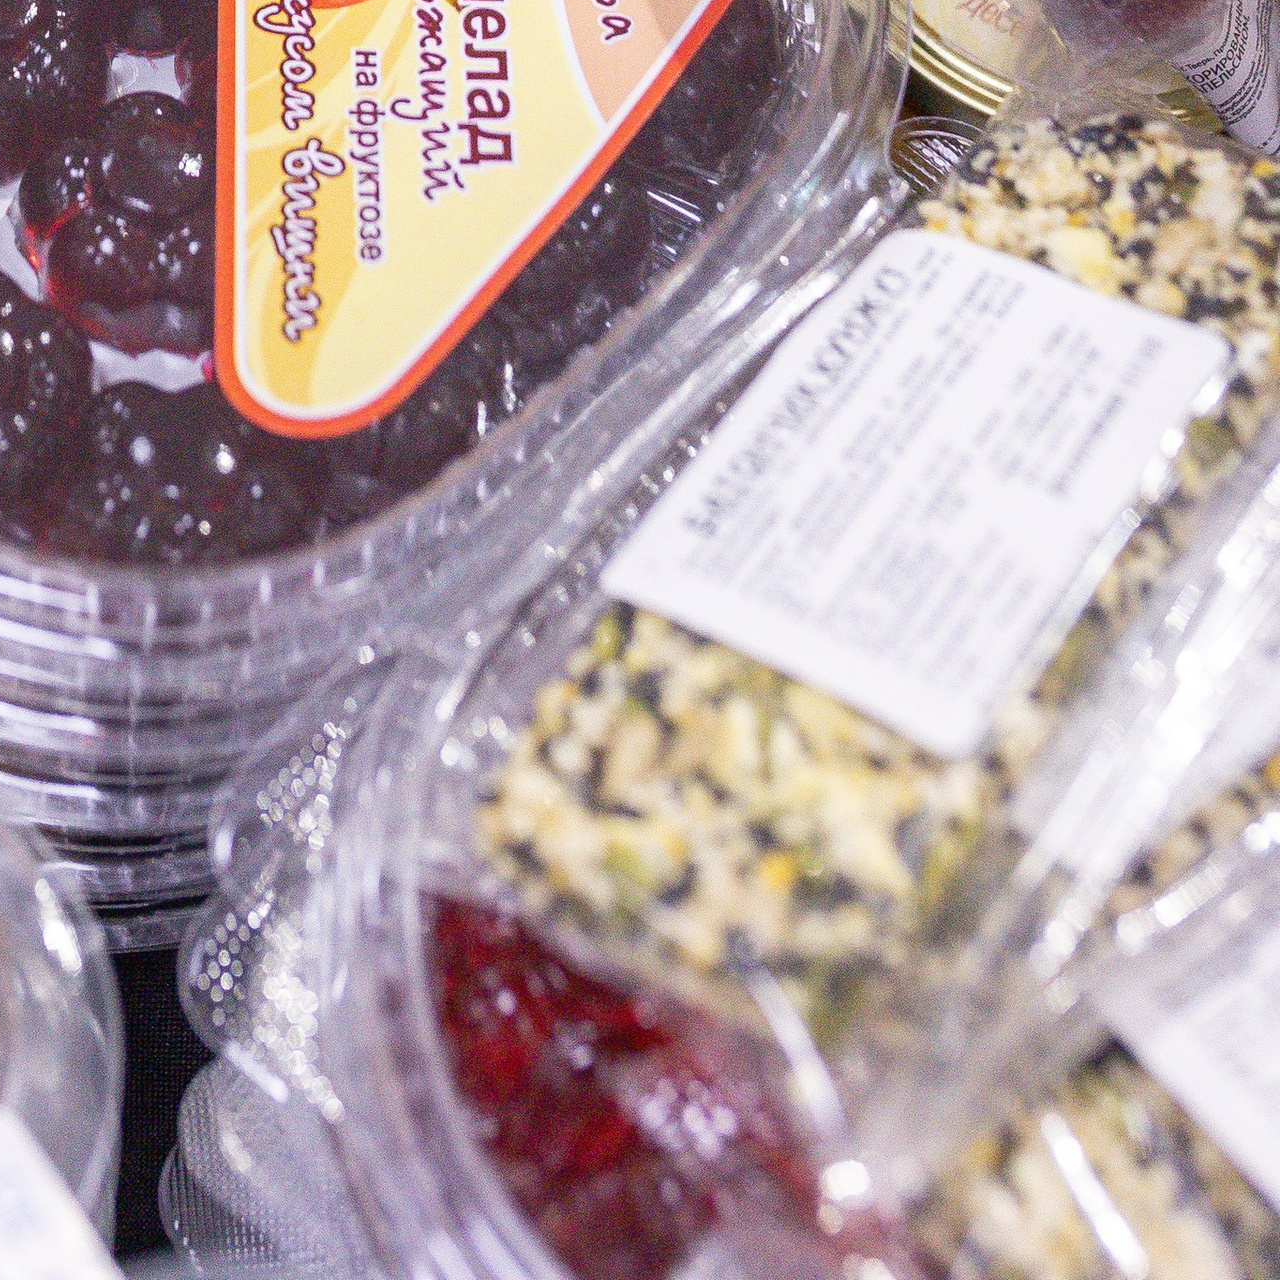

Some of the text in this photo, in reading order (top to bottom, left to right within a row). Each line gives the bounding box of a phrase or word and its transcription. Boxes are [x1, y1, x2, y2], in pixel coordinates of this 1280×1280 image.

[270, 137, 346, 344] вишни
[348, 48, 385, 264] на фруктозе
